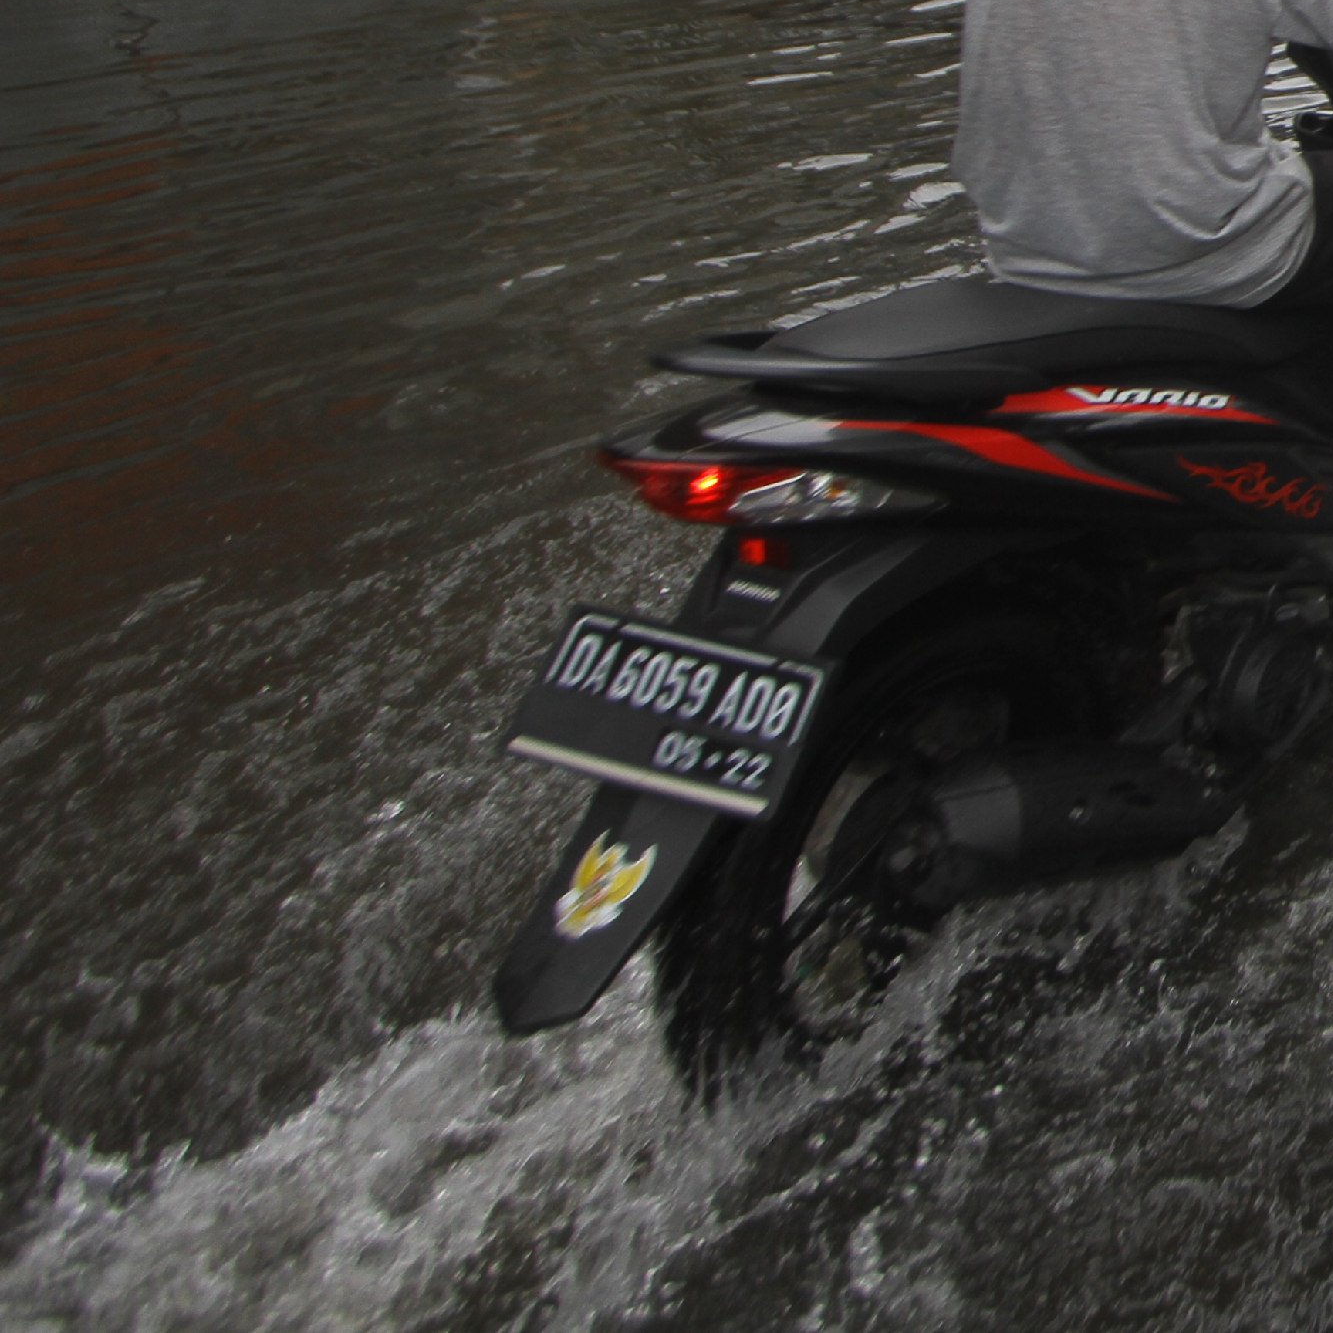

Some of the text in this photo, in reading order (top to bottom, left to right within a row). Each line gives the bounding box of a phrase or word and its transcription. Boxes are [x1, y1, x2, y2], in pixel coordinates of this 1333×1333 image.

[1066, 387, 1230, 409] VARIO
[557, 633, 624, 695] DA
[605, 646, 720, 719] 6059
